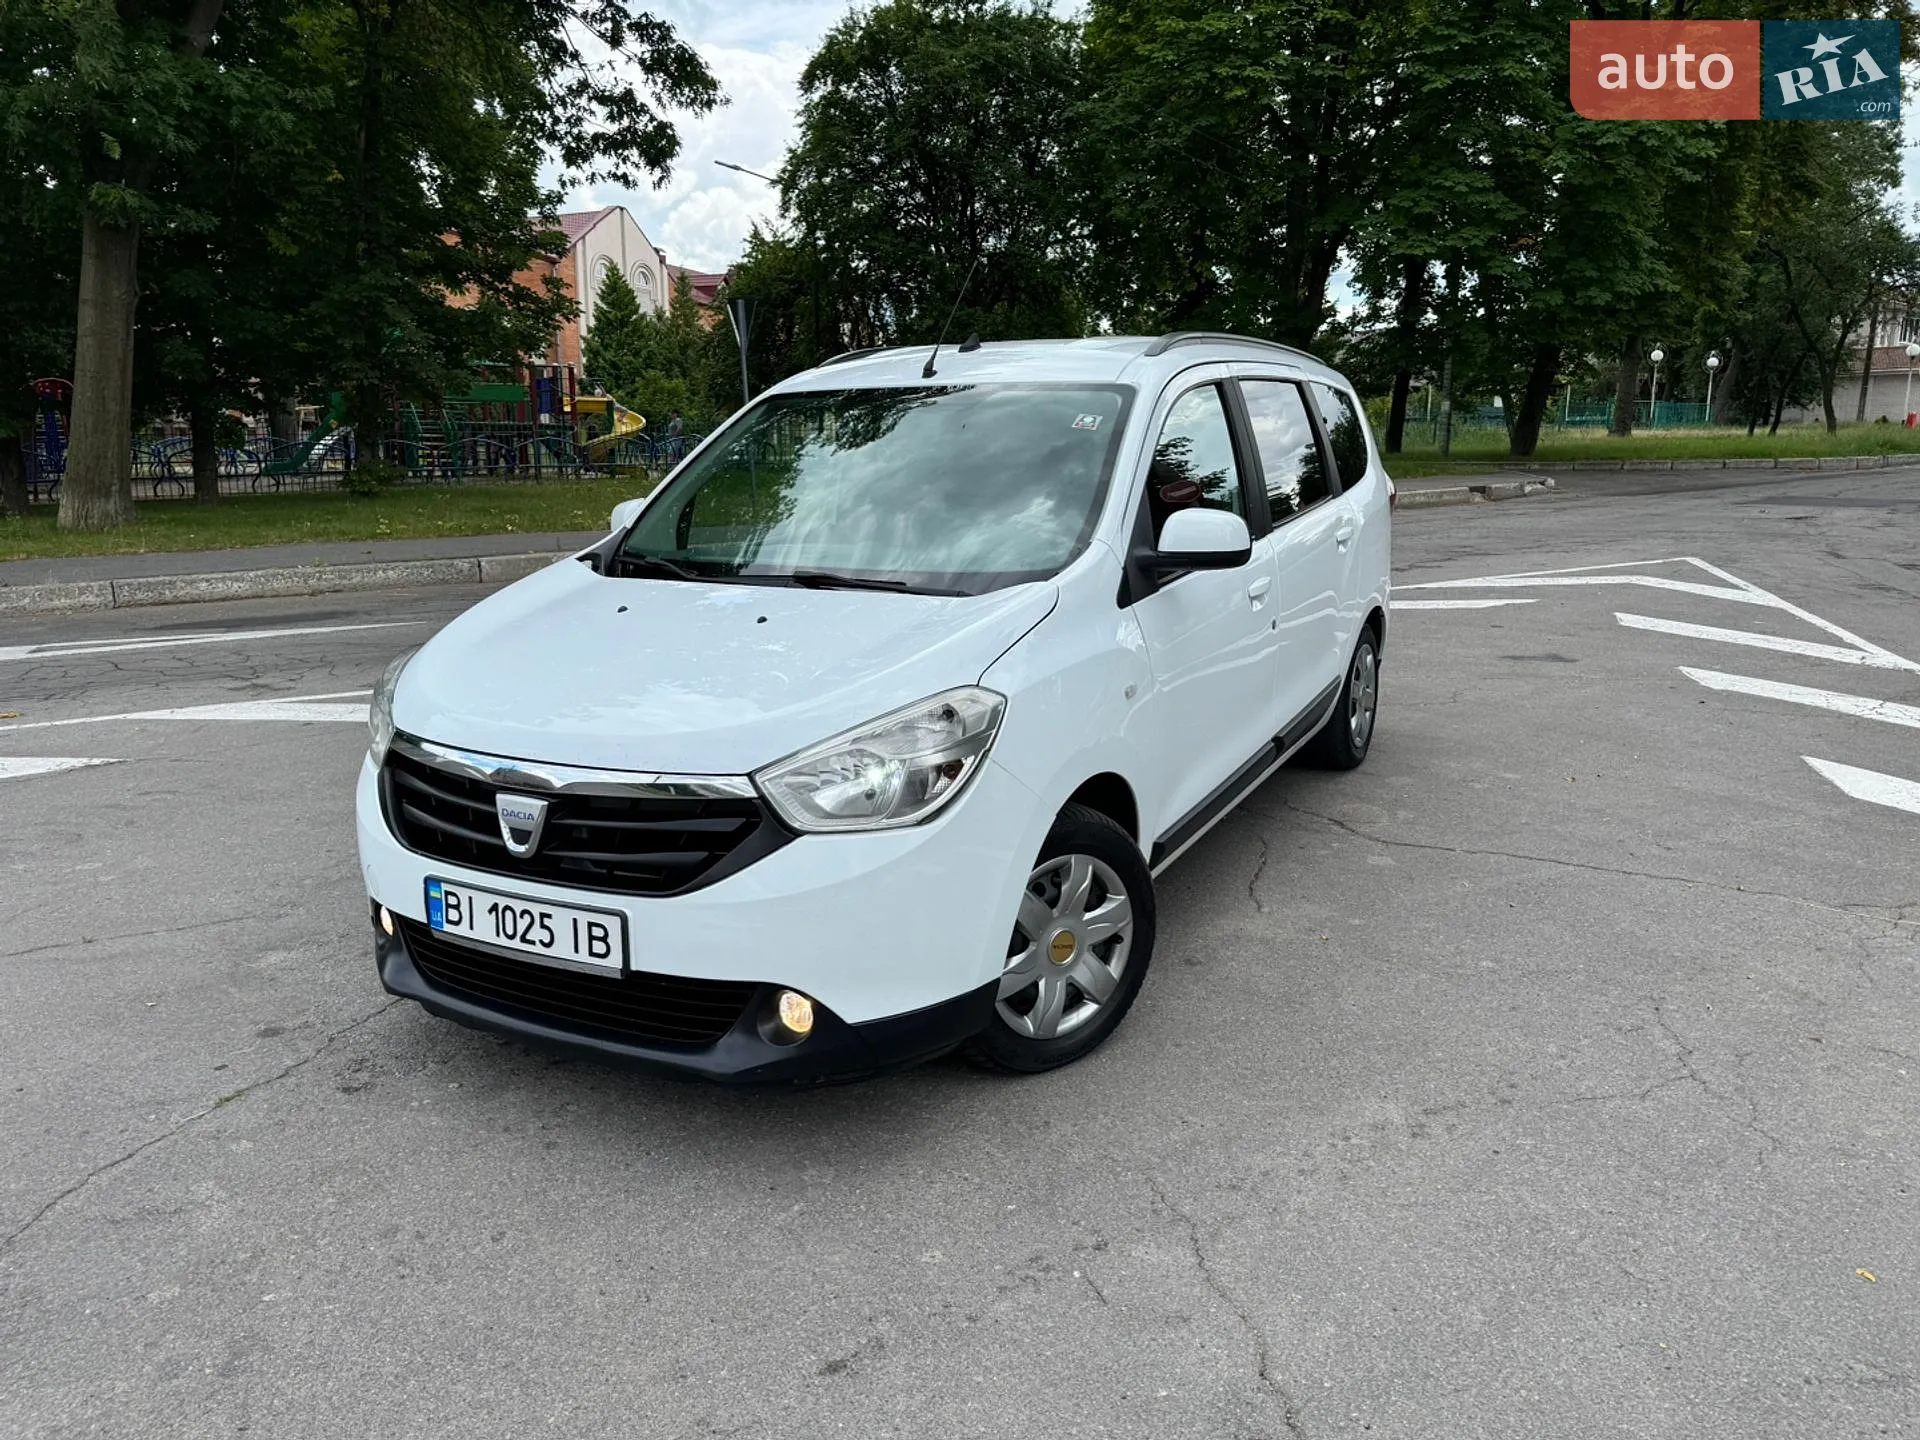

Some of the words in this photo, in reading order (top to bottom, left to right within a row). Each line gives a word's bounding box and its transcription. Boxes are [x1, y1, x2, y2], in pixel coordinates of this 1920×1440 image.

[501, 807, 536, 822] DACIA
[431, 909, 442, 922] UA
[444, 889, 474, 931] BI
[487, 902, 555, 949] 1025
[572, 917, 612, 960] IB
